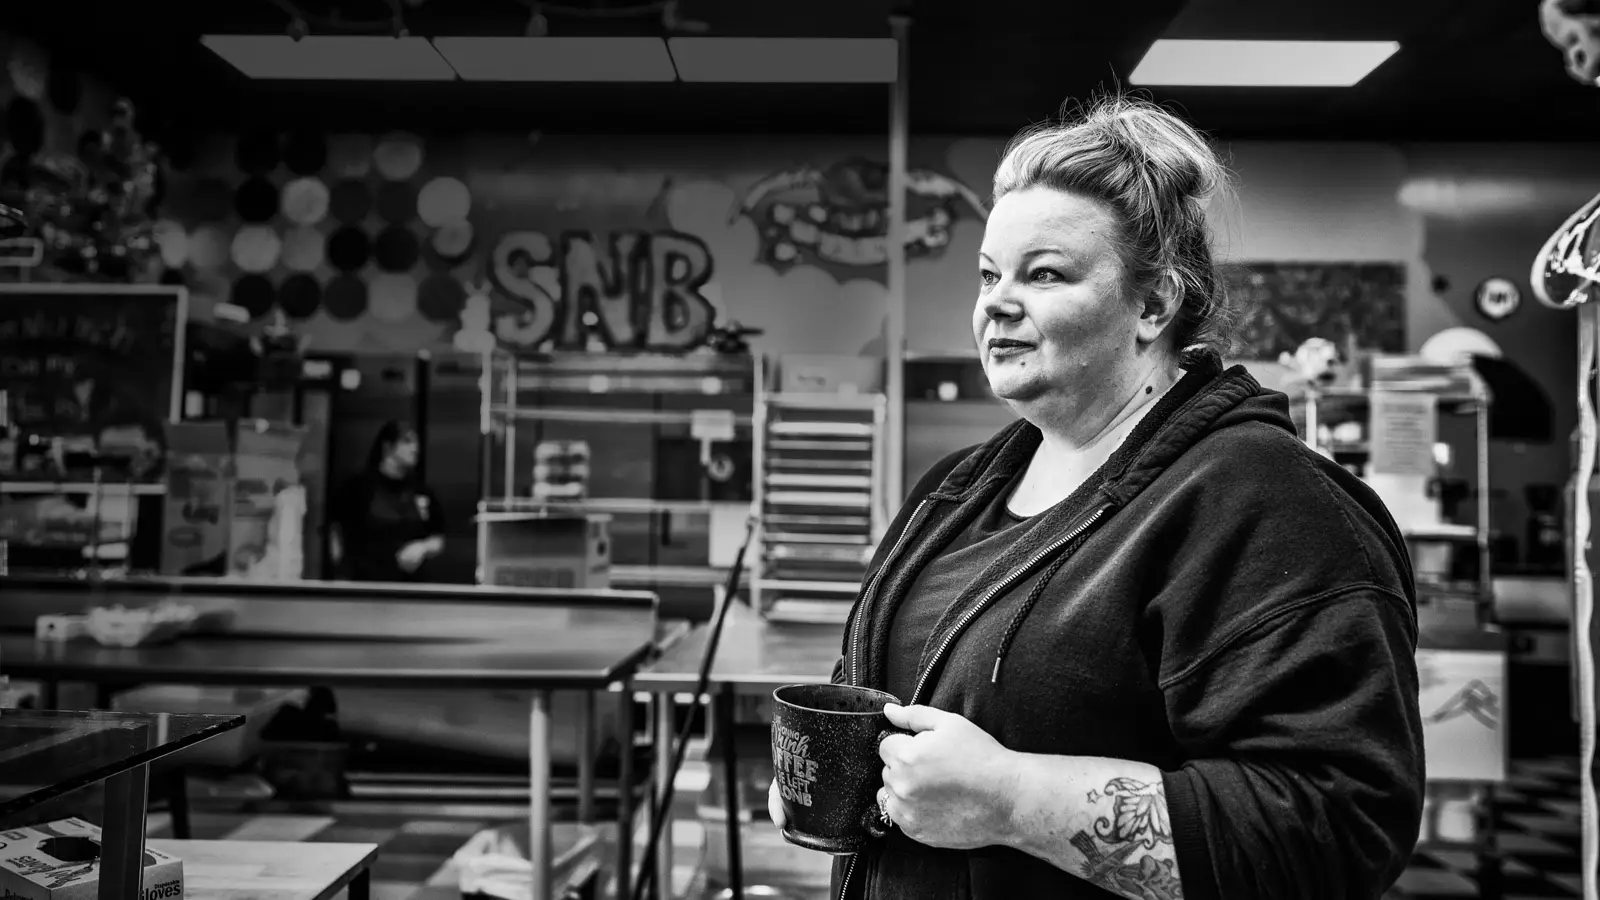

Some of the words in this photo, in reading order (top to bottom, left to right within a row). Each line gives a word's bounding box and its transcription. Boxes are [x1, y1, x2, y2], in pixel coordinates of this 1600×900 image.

[489, 229, 712, 350] SNB
[786, 772, 811, 794] LEFT
[141, 884, 181, 900] loves
